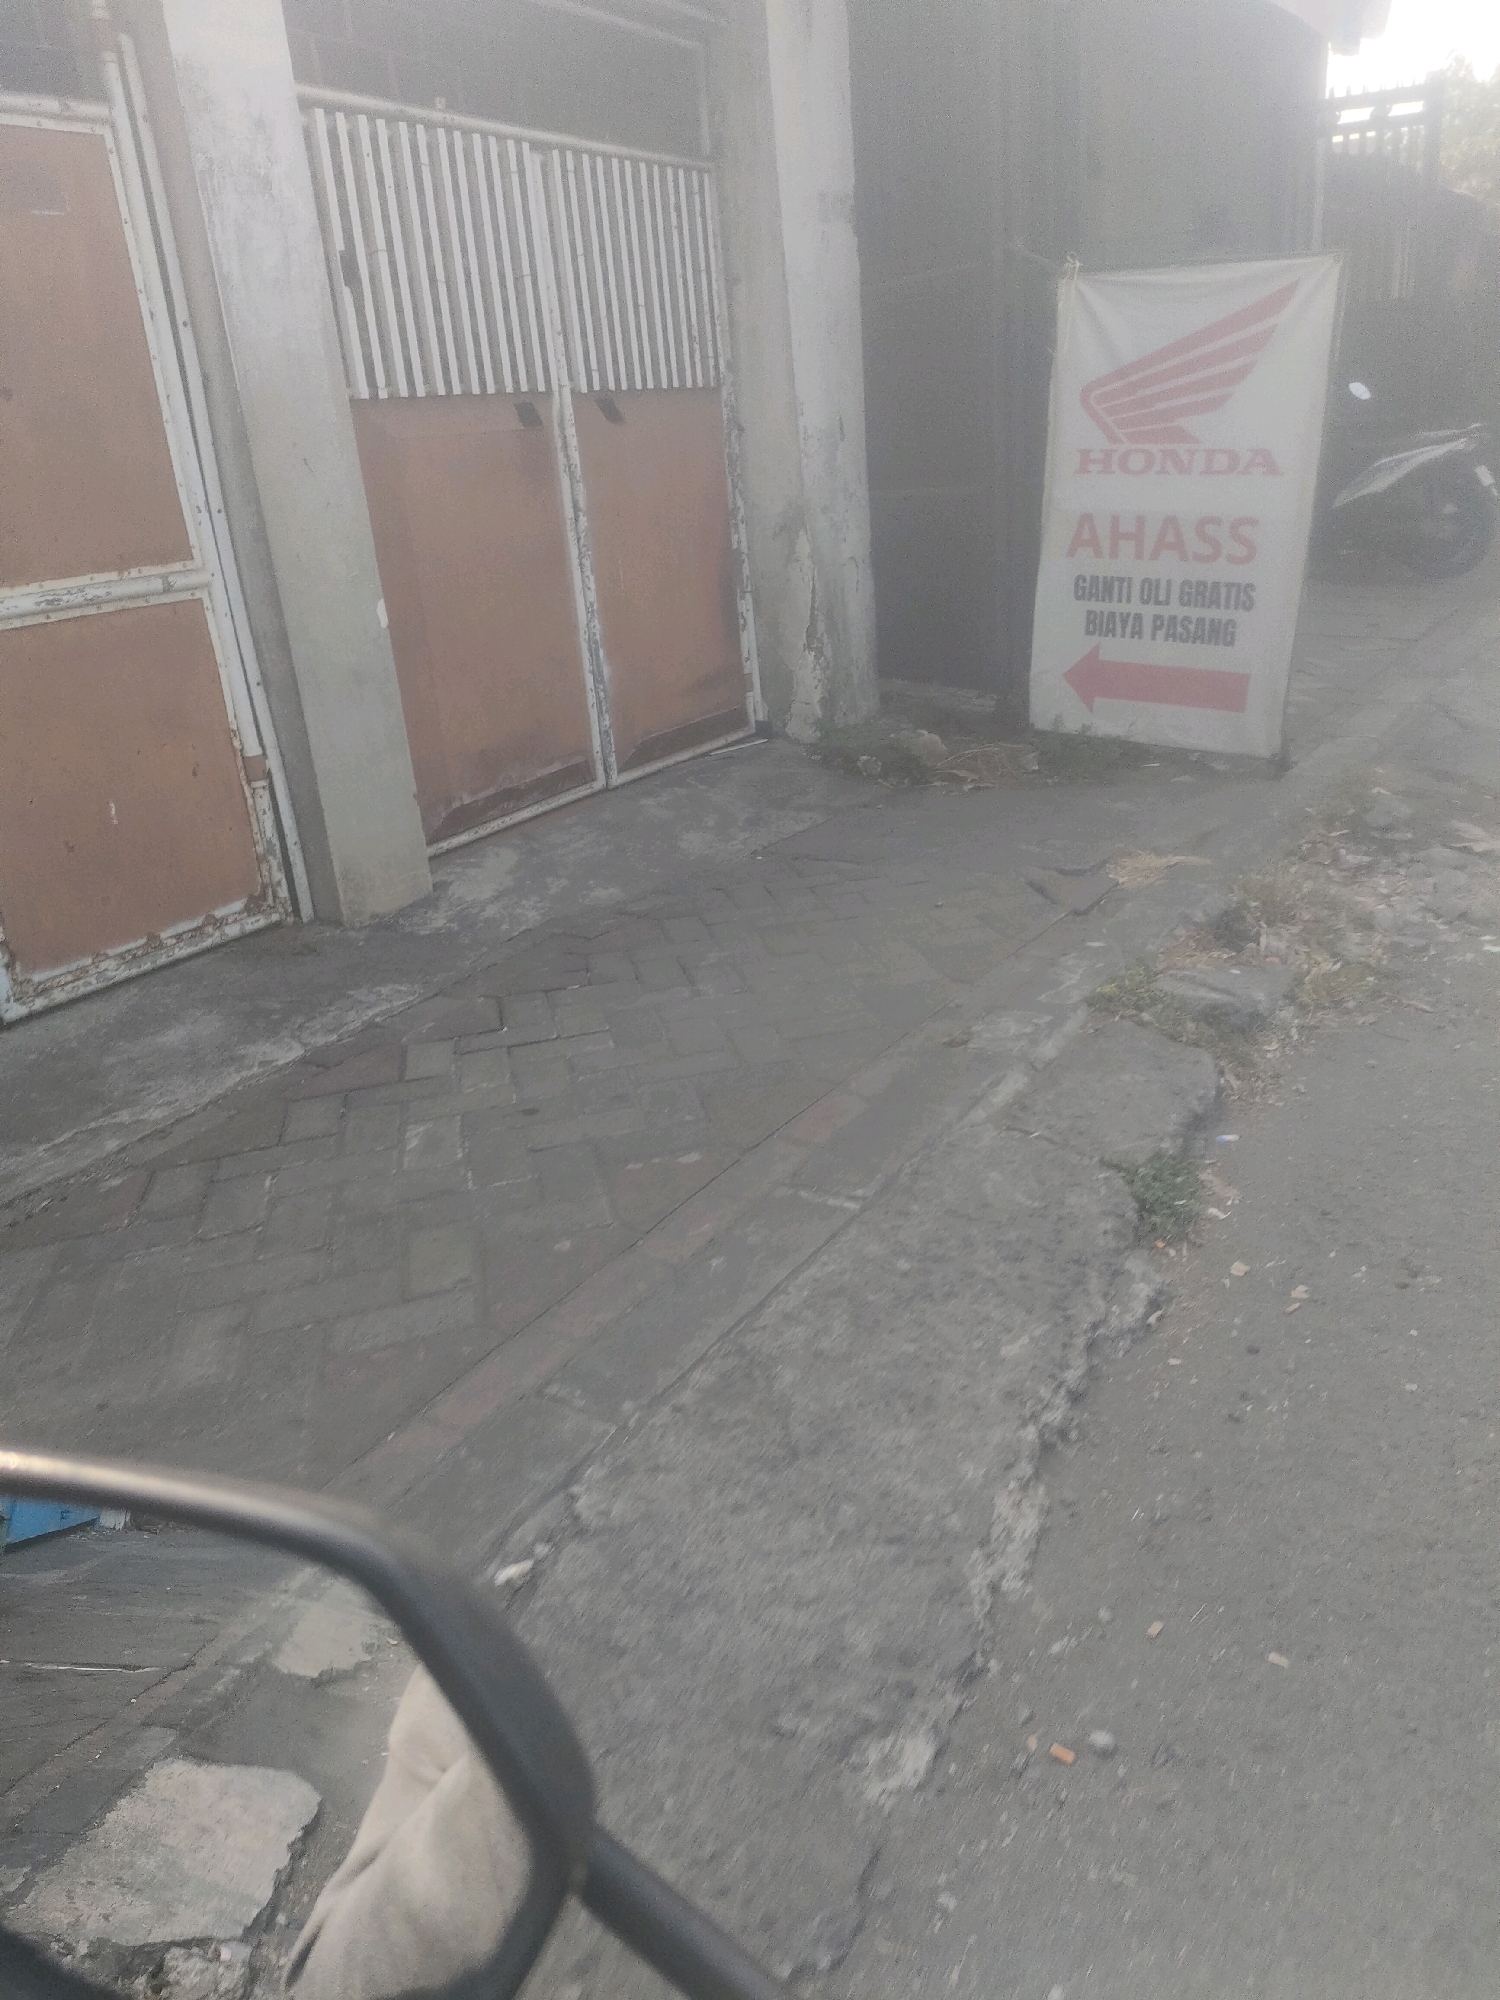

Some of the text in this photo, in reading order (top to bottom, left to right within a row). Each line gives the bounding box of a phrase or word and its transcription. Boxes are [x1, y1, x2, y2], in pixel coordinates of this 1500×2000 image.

[1076, 448, 1281, 475] HONDA
[1065, 513, 1259, 565] AHASS
[1073, 574, 1256, 612] GANTI OLI GRATIS
[1085, 609, 1237, 647] BIAYA PASANG
